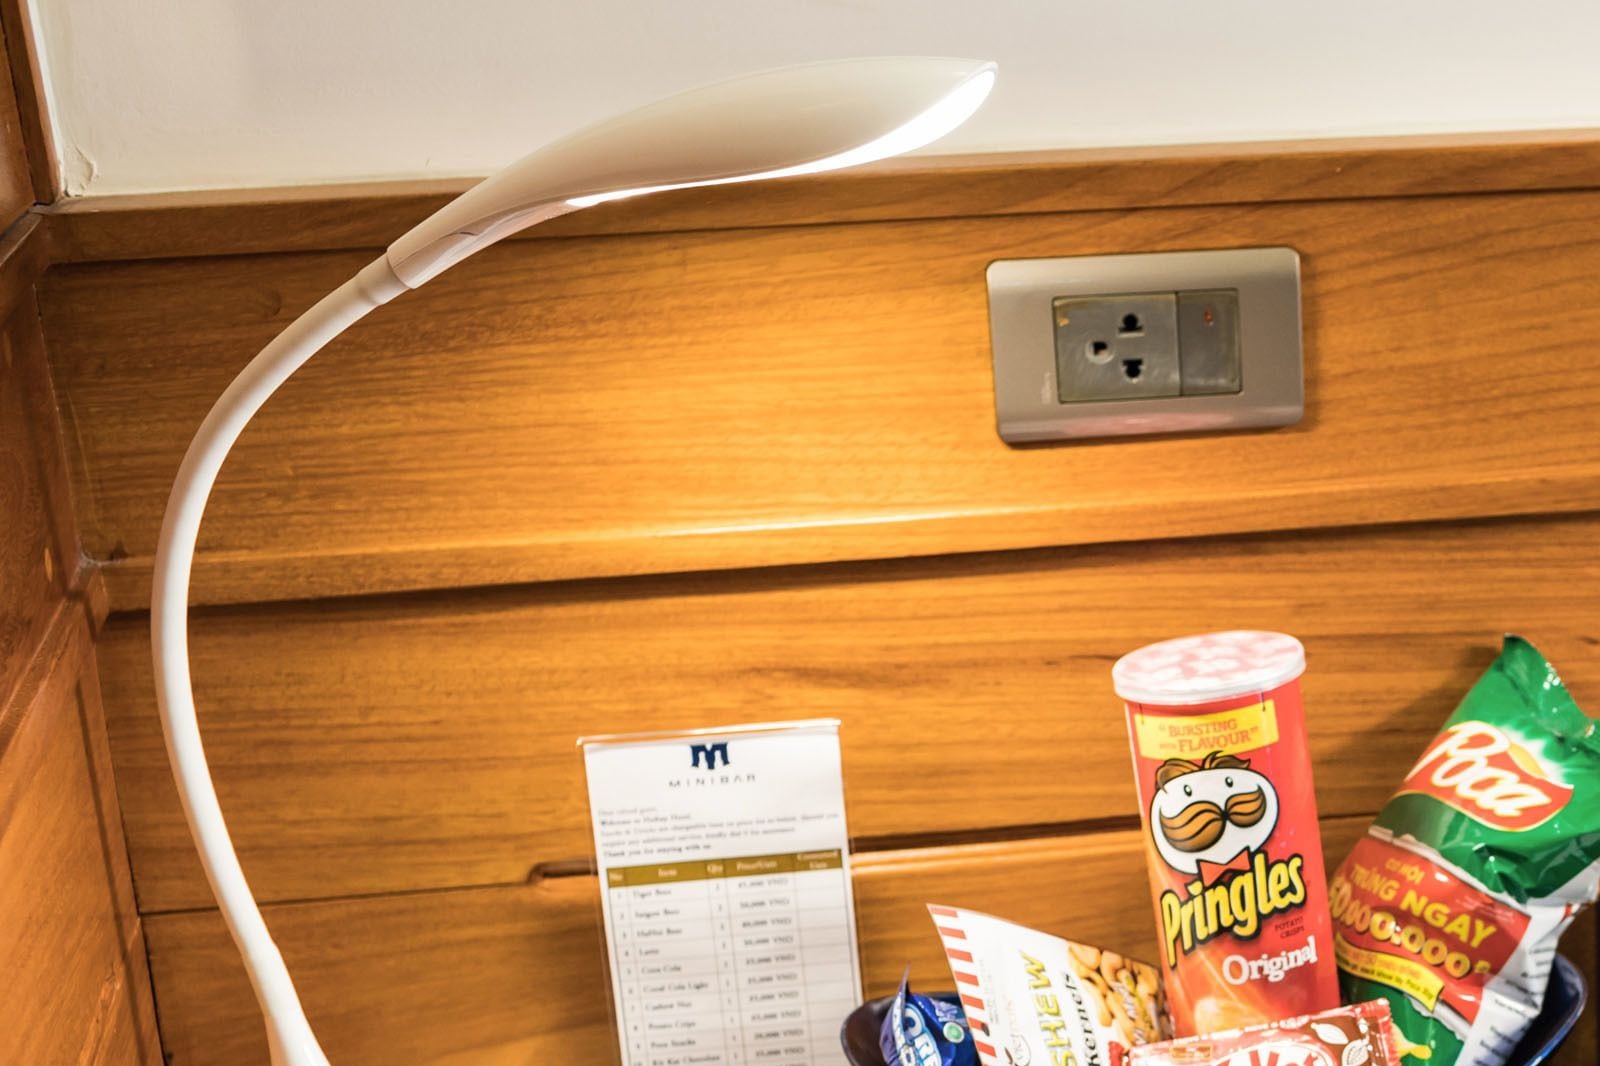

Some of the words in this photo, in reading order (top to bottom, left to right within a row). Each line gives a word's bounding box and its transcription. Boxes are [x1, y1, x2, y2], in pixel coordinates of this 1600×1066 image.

[668, 773, 756, 788] MINIBAR
[1404, 720, 1552, 817] Poca
[1161, 852, 1306, 968] Pringles
[1400, 889, 1497, 949] NGAY
[1221, 934, 1318, 986] Original
